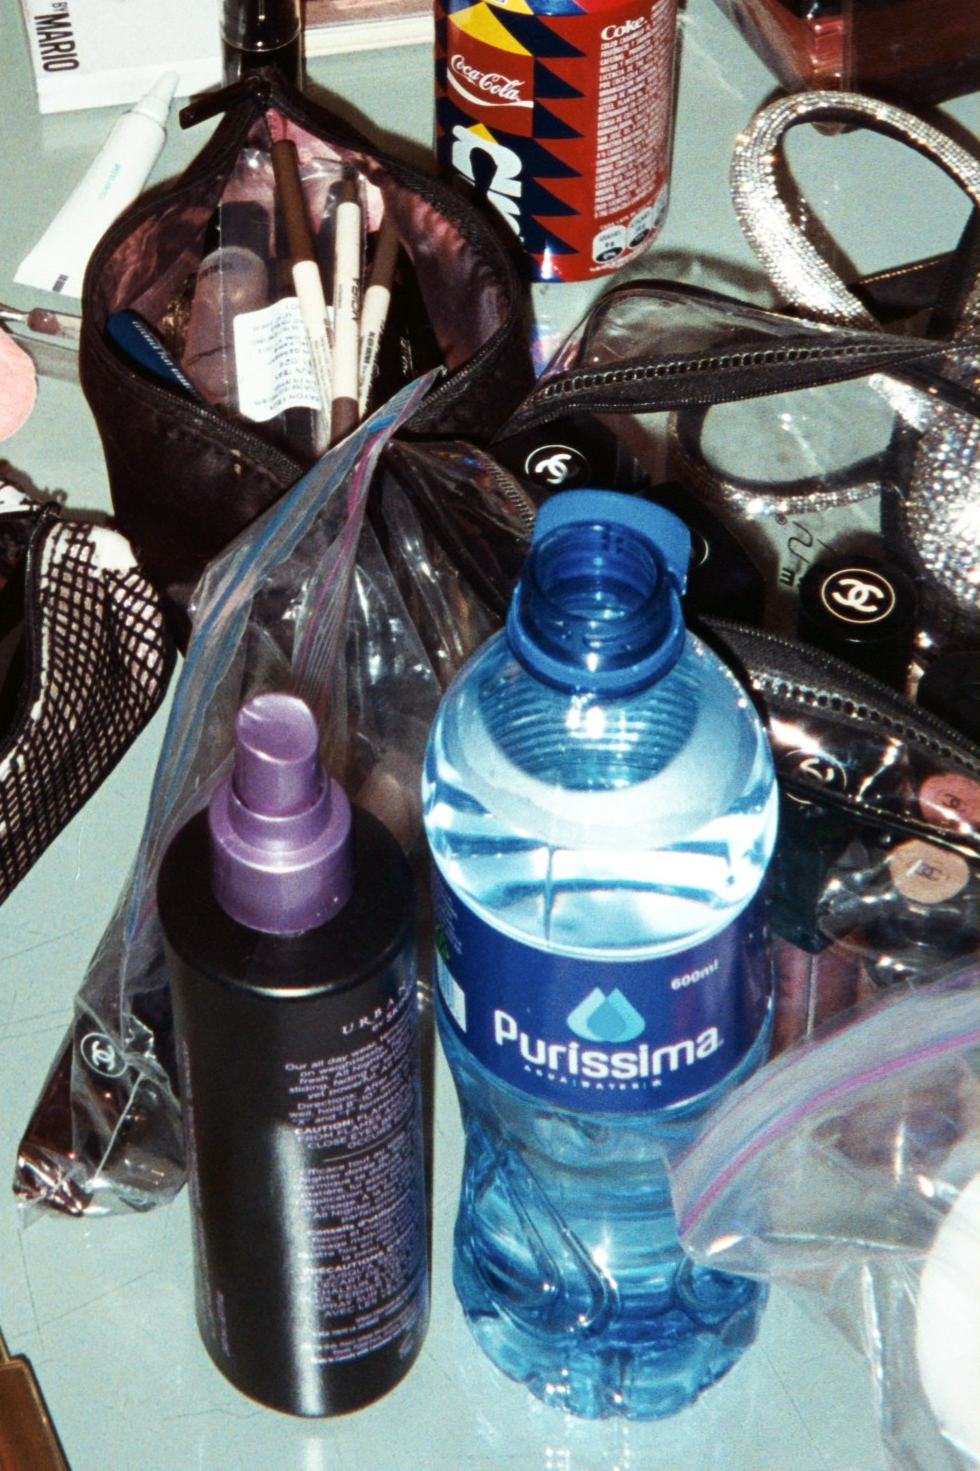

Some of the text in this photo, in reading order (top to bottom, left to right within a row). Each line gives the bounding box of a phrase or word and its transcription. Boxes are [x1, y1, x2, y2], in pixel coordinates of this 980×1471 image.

[51, 2, 67, 12] BY
[34, 13, 79, 71] MARIO
[450, 54, 523, 103] Coca-Cola
[671, 960, 719, 991] 600ml
[493, 1010, 719, 1080] Purissima
